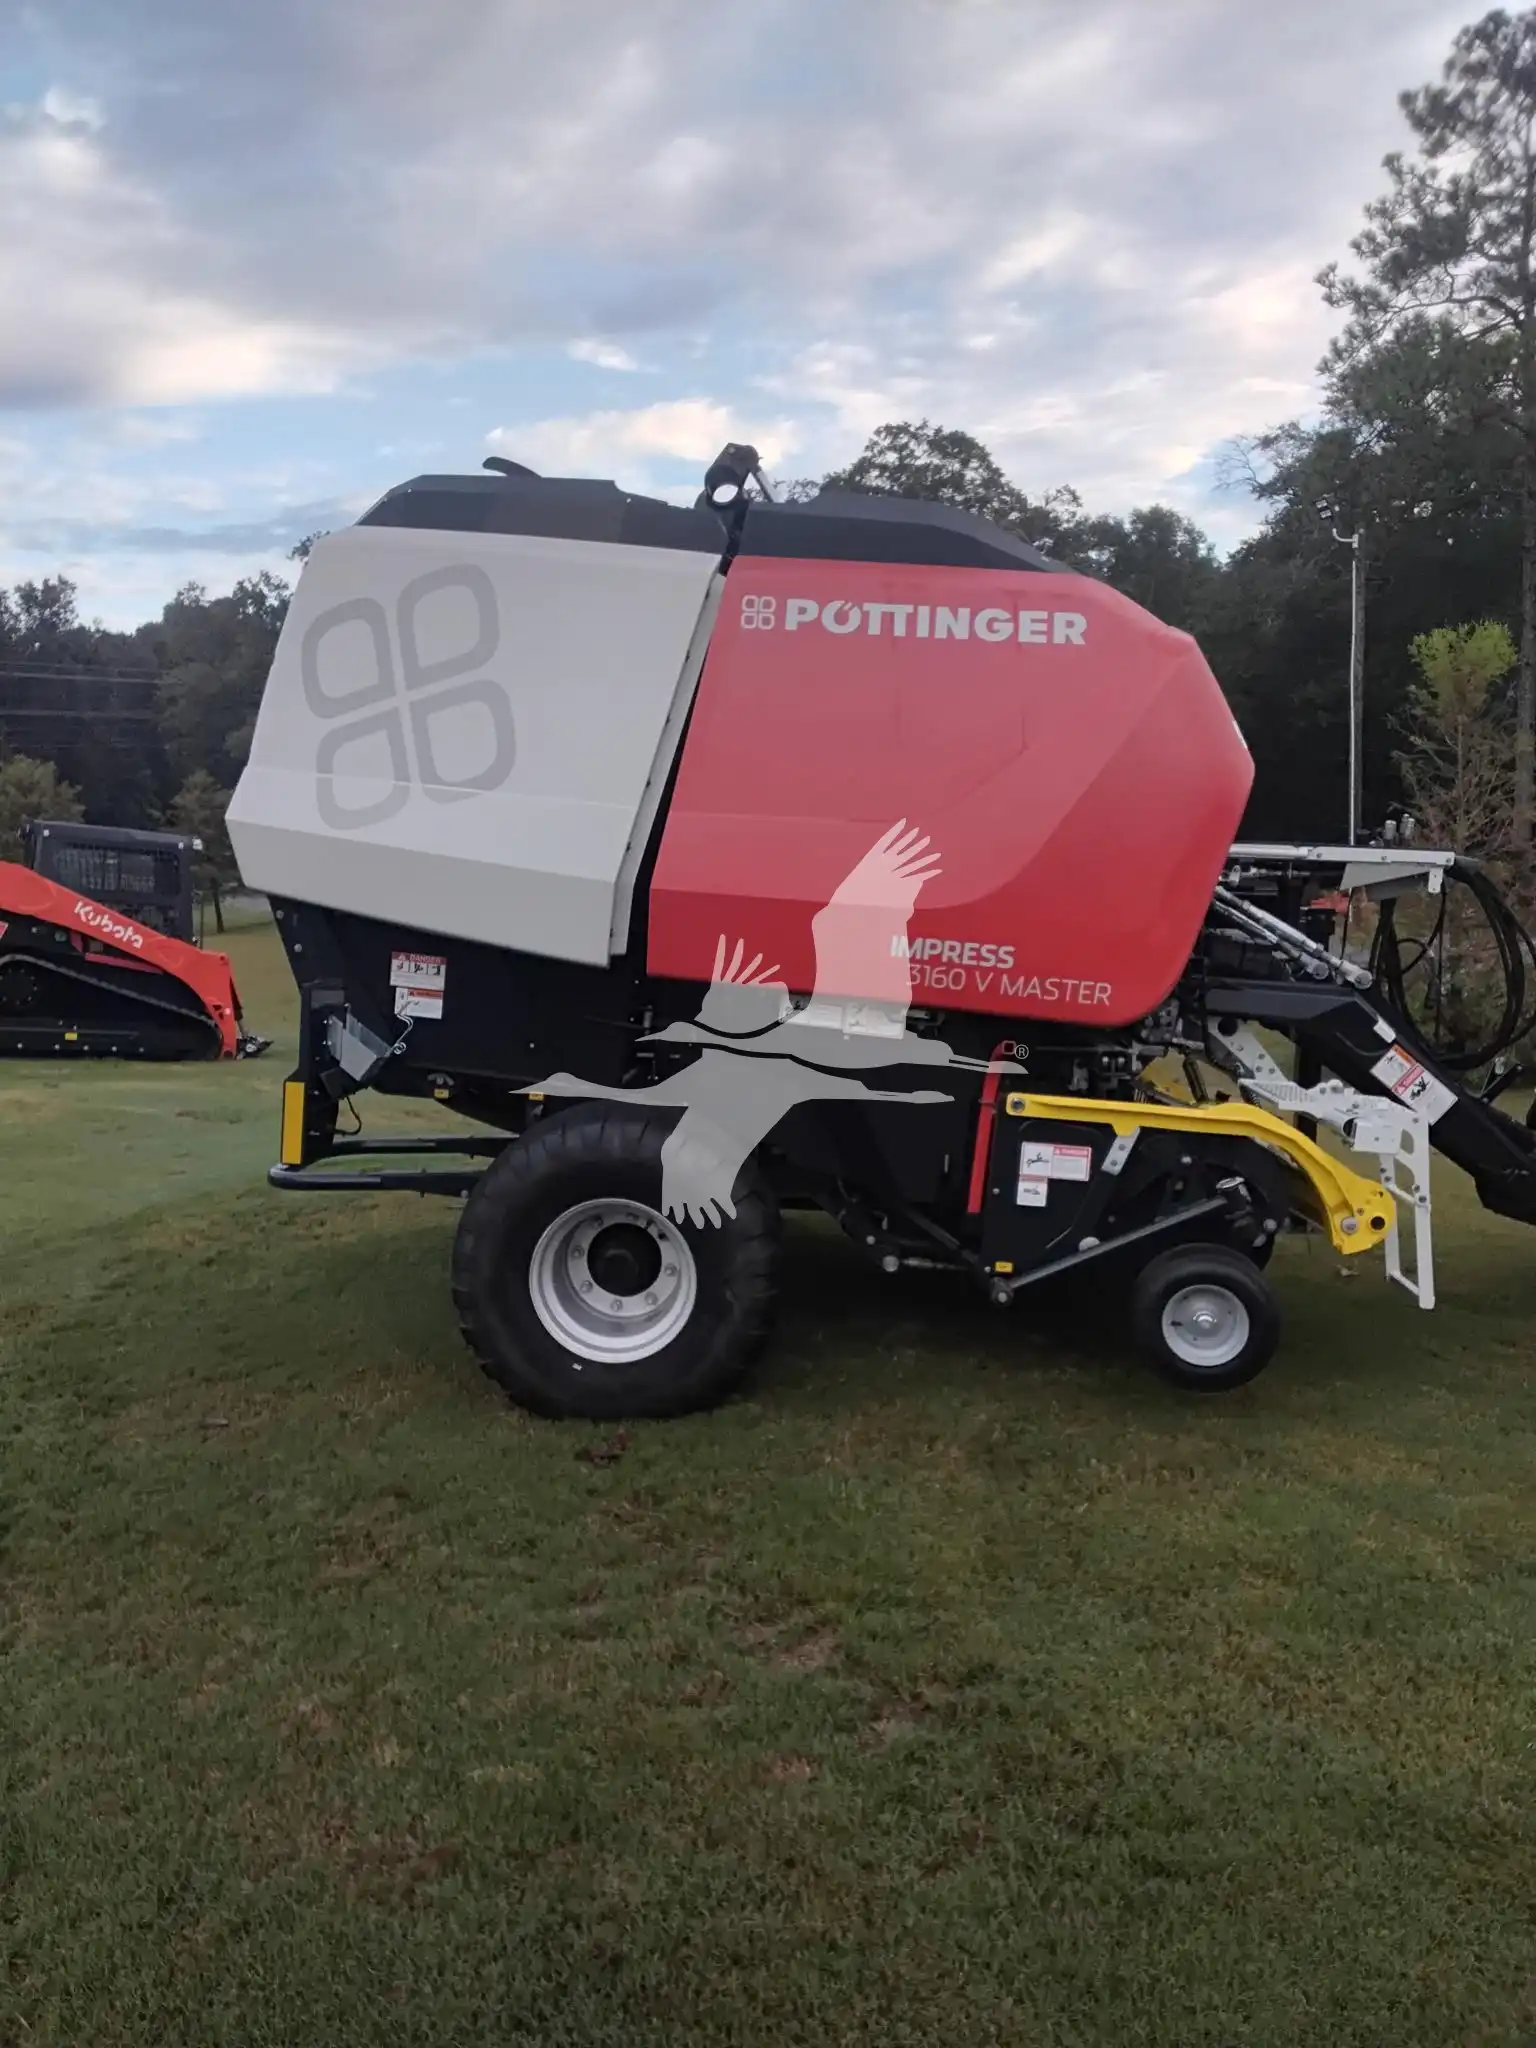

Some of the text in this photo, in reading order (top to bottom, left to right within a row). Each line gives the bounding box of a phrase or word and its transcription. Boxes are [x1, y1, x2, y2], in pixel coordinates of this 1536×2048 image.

[74, 901, 144, 949] Kubota
[891, 936, 1015, 968] IMPRESS
[906, 964, 1112, 1006] 3160 V MASTER
